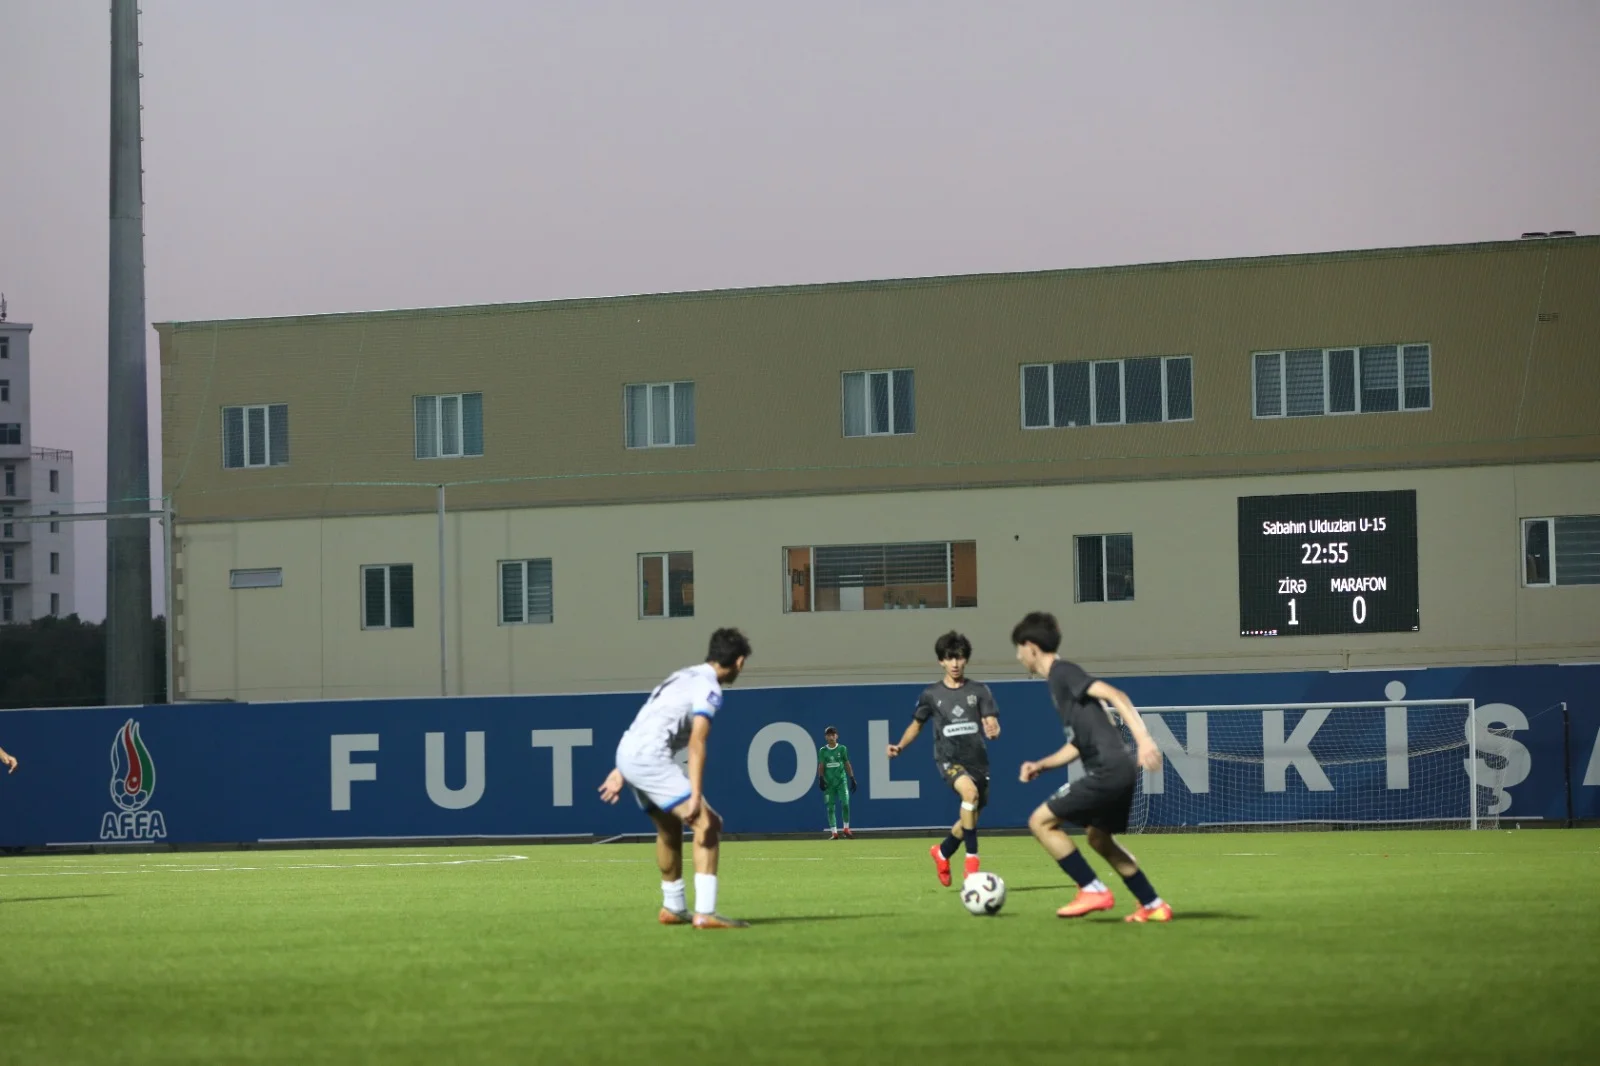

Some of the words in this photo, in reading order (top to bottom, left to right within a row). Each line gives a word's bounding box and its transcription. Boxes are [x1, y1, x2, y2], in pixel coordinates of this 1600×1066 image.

[1359, 517, 1387, 531] U-15
[1301, 542, 1349, 564] 22:55
[1278, 576, 1307, 594] ZİRƏ
[1330, 576, 1387, 592] MARAFON
[1287, 598, 1299, 625] 1
[1352, 596, 1367, 624] 0
[331, 719, 920, 811] FUTOL
[1067, 680, 1600, 815] NKİŞ
[100, 810, 167, 839] AFFA
